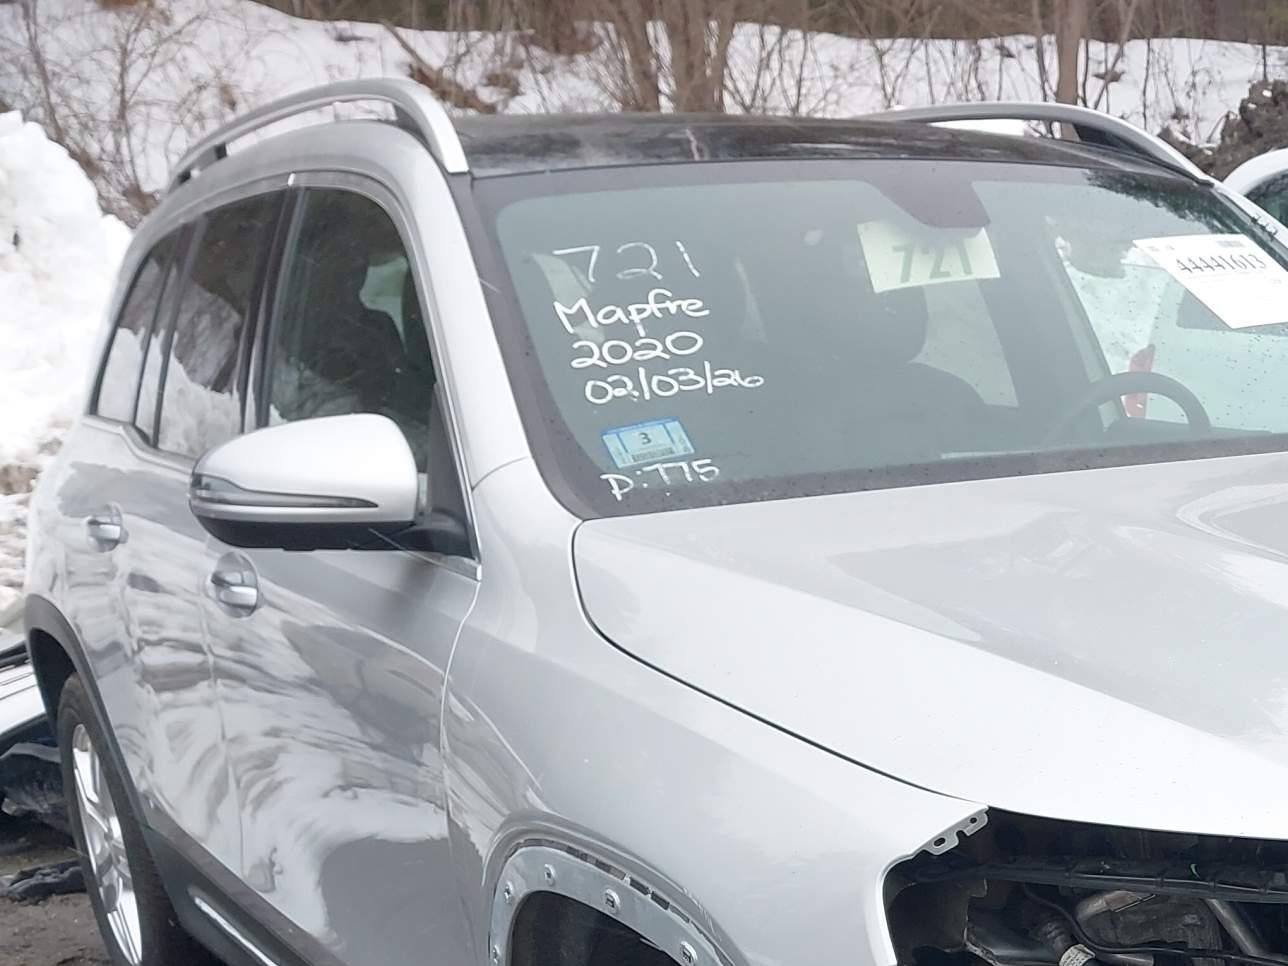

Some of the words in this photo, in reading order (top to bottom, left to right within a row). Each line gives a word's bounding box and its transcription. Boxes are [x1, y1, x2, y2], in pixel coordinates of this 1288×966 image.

[553, 240, 701, 283] 721
[892, 239, 974, 283] 721
[1176, 253, 1267, 273] 44441613
[553, 288, 710, 338] Mapfre
[571, 331, 704, 368] 2020
[584, 360, 765, 405] 02/03/26
[638, 432, 652, 445] 3
